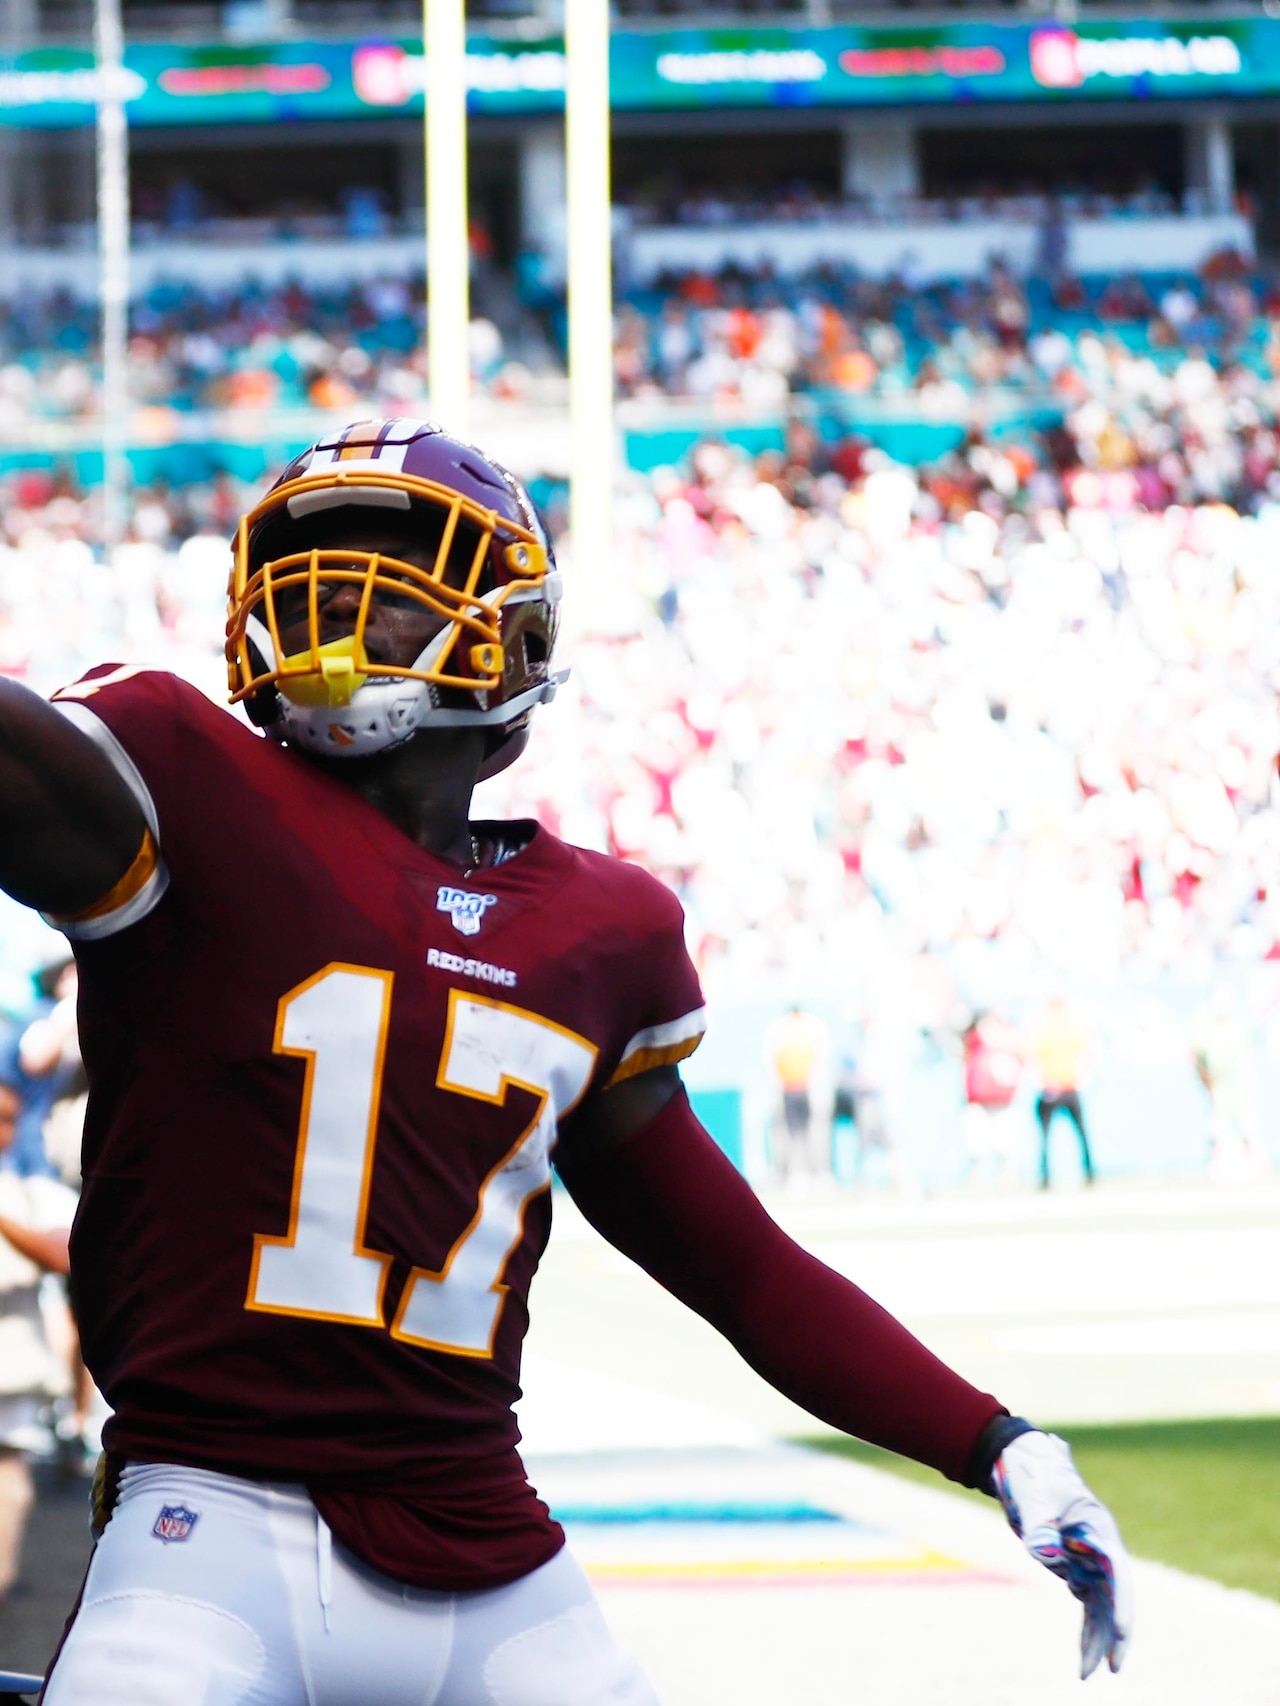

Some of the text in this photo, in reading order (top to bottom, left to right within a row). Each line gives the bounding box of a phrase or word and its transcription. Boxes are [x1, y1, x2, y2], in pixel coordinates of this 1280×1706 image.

[426, 947, 518, 988] REDSKINS
[244, 960, 600, 1360] 17
[155, 1516, 190, 1539] NFL
